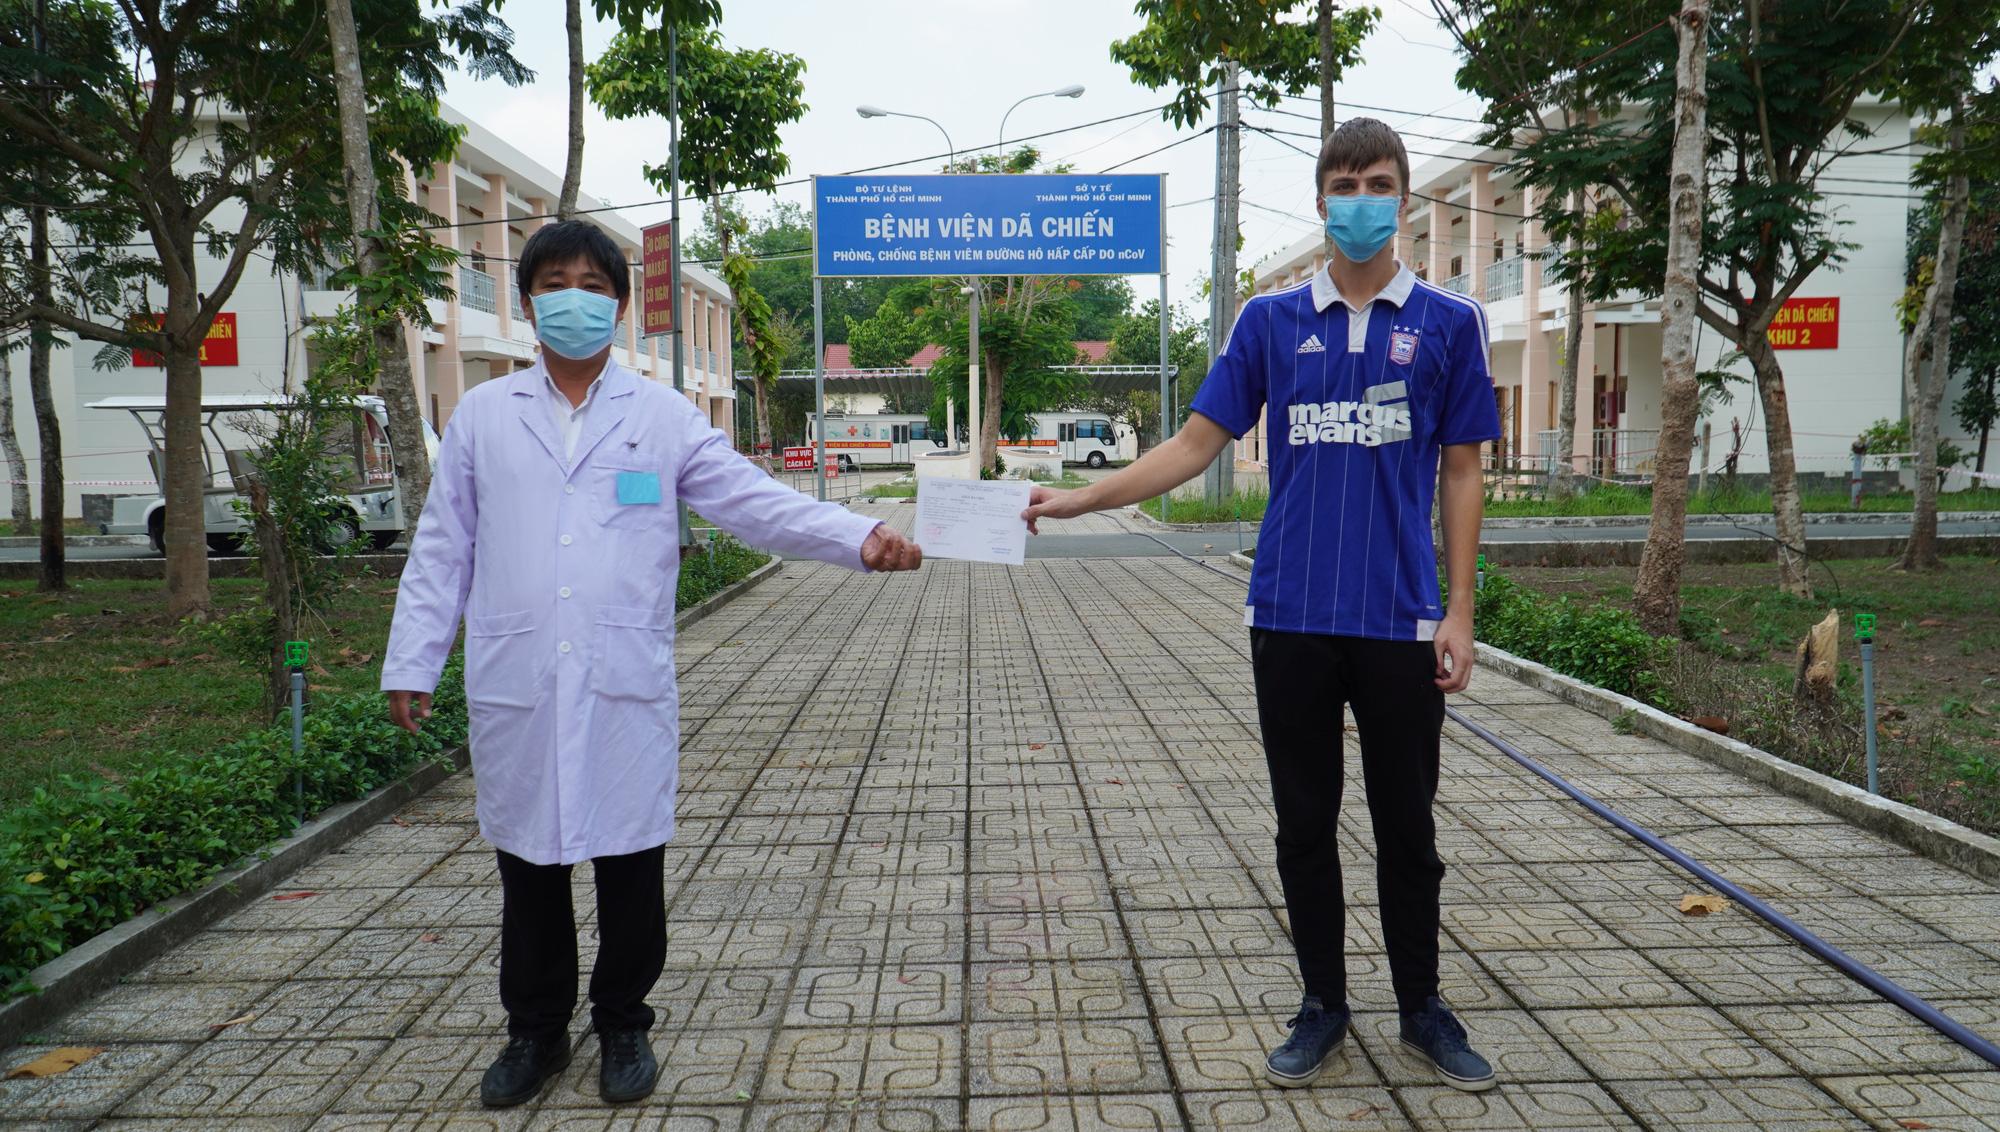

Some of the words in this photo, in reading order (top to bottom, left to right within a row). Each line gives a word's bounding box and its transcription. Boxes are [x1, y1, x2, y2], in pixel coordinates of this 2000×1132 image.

[856, 185, 868, 193] BỘ
[887, 184, 912, 193] LỆNH
[1075, 183, 1088, 192] SỞ
[1100, 183, 1112, 192] TẾ
[826, 194, 857, 202] THÀNH
[860, 194, 880, 202] PHỐ
[883, 194, 896, 202] HỒ
[1036, 193, 1067, 202] THÀNH
[1071, 193, 1090, 202] PHỐ
[1093, 193, 1106, 201] HỒ
[1109, 193, 1125, 201] CHÍ
[865, 212, 929, 242] BỆNH
[938, 212, 993, 242] VIỆN
[1002, 212, 1033, 238] DÃ
[1042, 209, 1113, 237] CHIẾN
[833, 248, 875, 262] PHÒNG,
[878, 246, 916, 261] CHỐNG
[920, 248, 950, 262] BỆNH
[954, 247, 983, 260] VIÊM
[986, 247, 1024, 260] ĐƯỜNG
[1028, 247, 1043, 260] HÔ
[1048, 246, 1070, 259] HẤP
[1073, 245, 1096, 259] CẤP
[1099, 249, 1114, 259] DO
[1118, 249, 1145, 259] nCoV
[1772, 308, 1790, 326] IỆN
[1793, 304, 1805, 323] DÃ
[1807, 302, 1834, 322] CHIẾN
[1767, 329, 1796, 345] KHU
[1800, 328, 1810, 344] 2
[199, 345, 208, 360] 1
[1298, 344, 1325, 353] adidas
[1288, 401, 1412, 432] marcus
[1289, 422, 1382, 447] evans
[800, 449, 812, 458] VỰC
[787, 459, 803, 467] CÁCH
